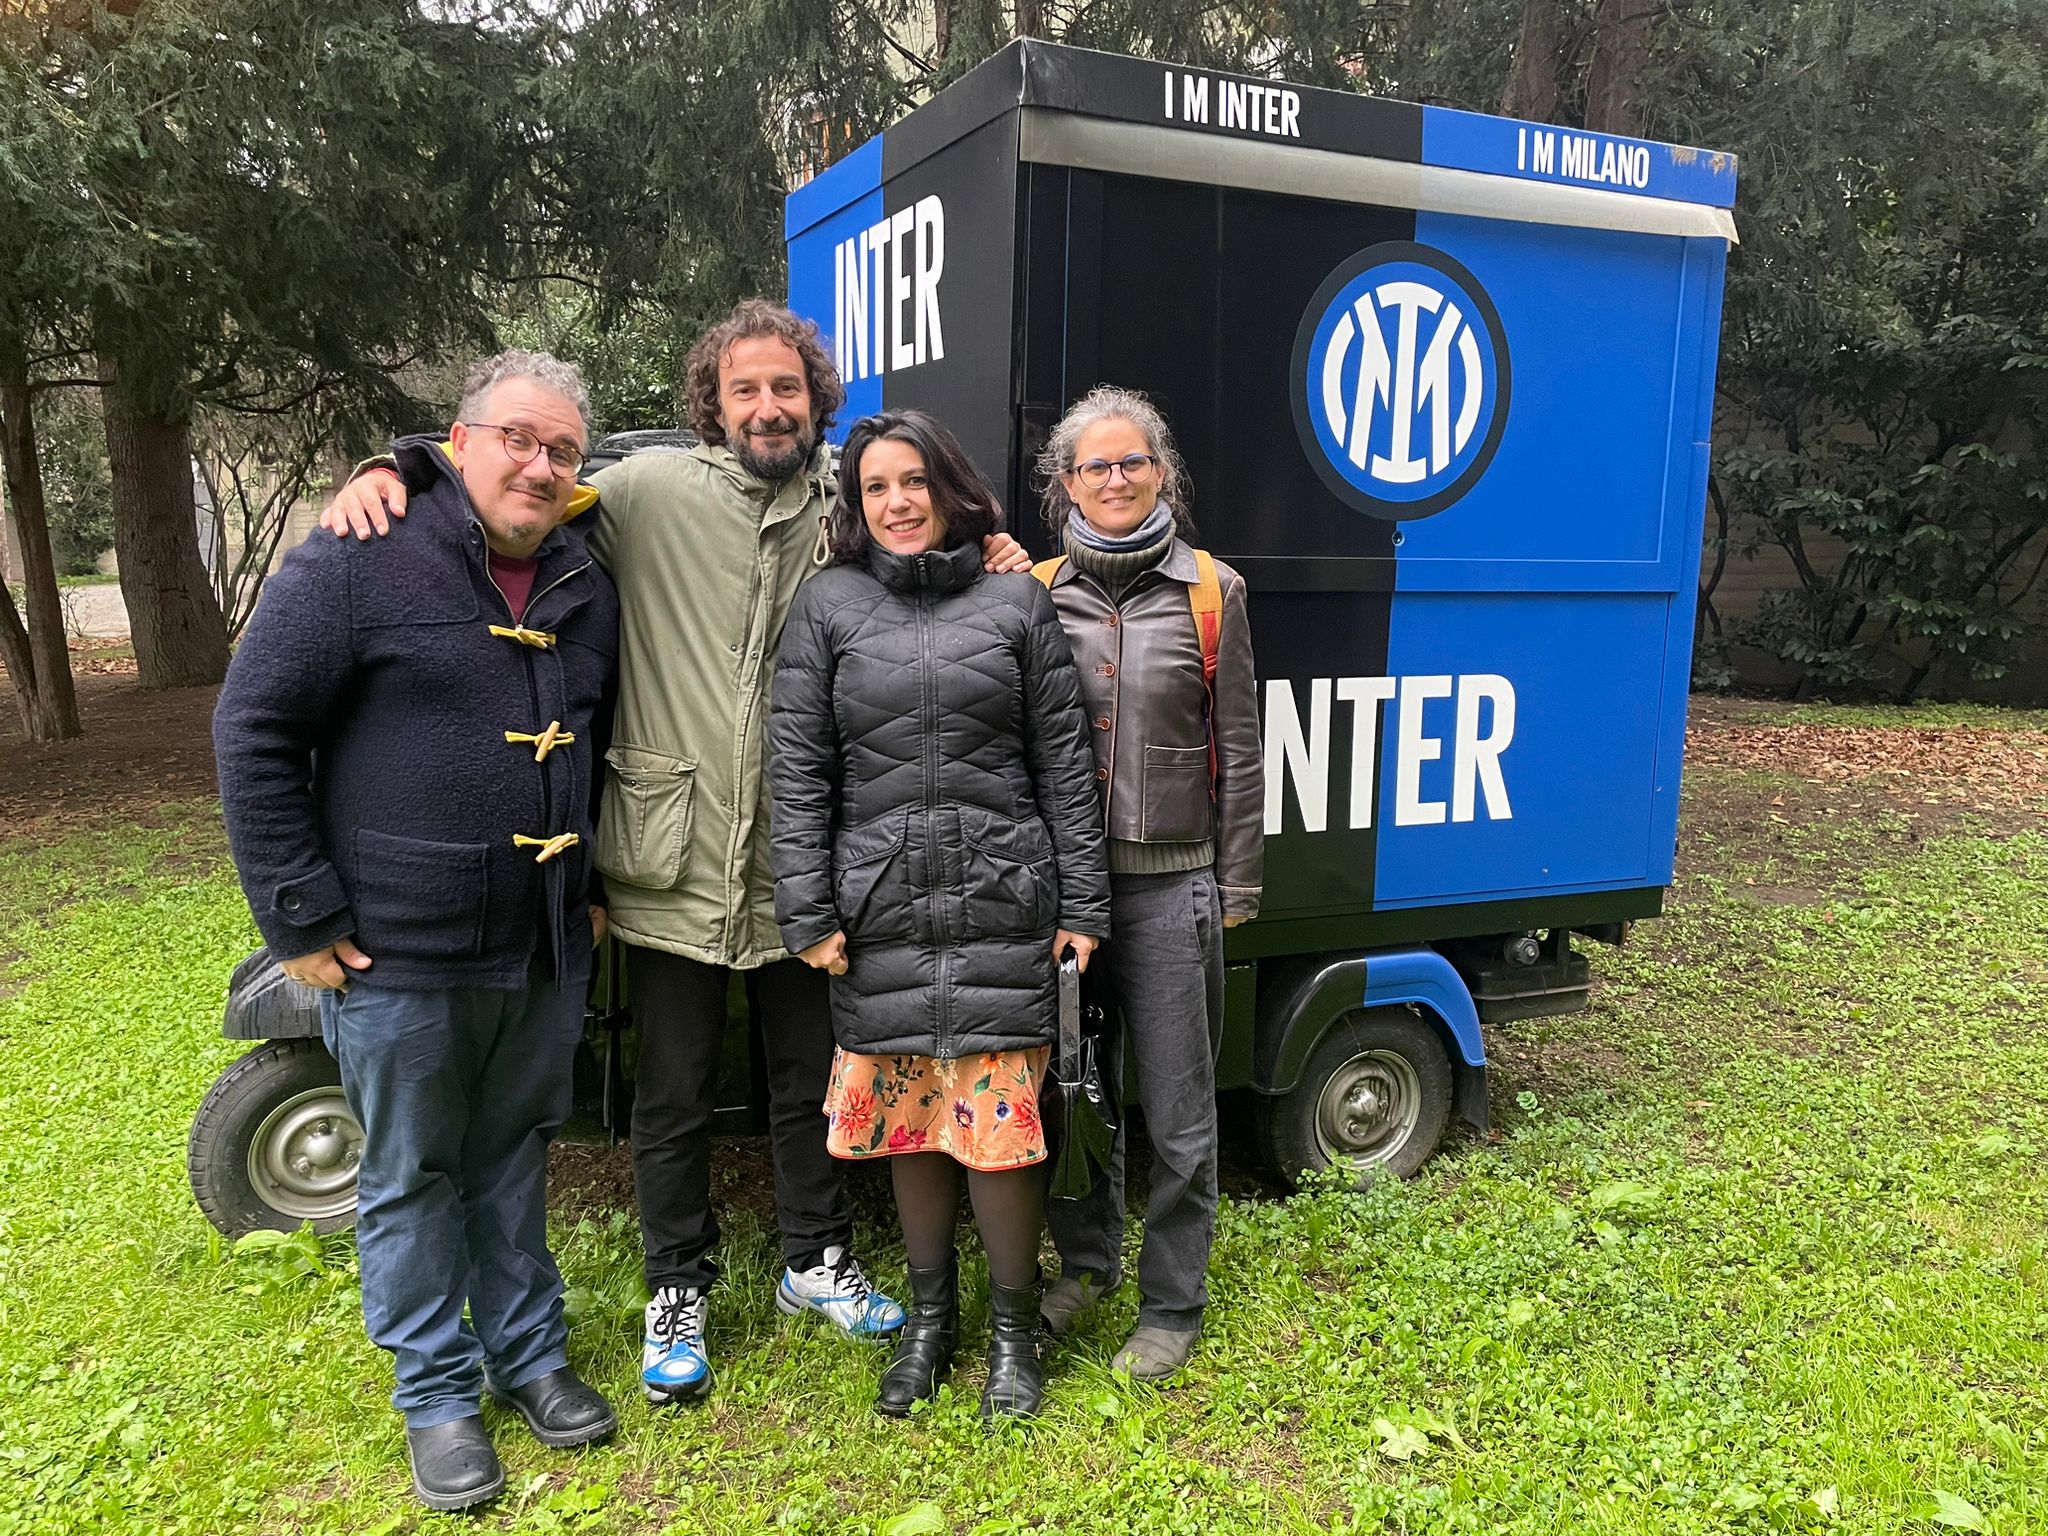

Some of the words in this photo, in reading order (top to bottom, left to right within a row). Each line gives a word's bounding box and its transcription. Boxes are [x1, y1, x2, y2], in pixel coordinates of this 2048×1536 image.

[1165, 71, 1173, 118] I
[1184, 74, 1208, 124] M
[1219, 79, 1300, 138] INTER
[1518, 128, 1526, 170] I
[1533, 131, 1555, 174] M
[1561, 135, 1650, 188] MILANO
[835, 194, 945, 385] INTER
[1254, 673, 1516, 836] NTER
